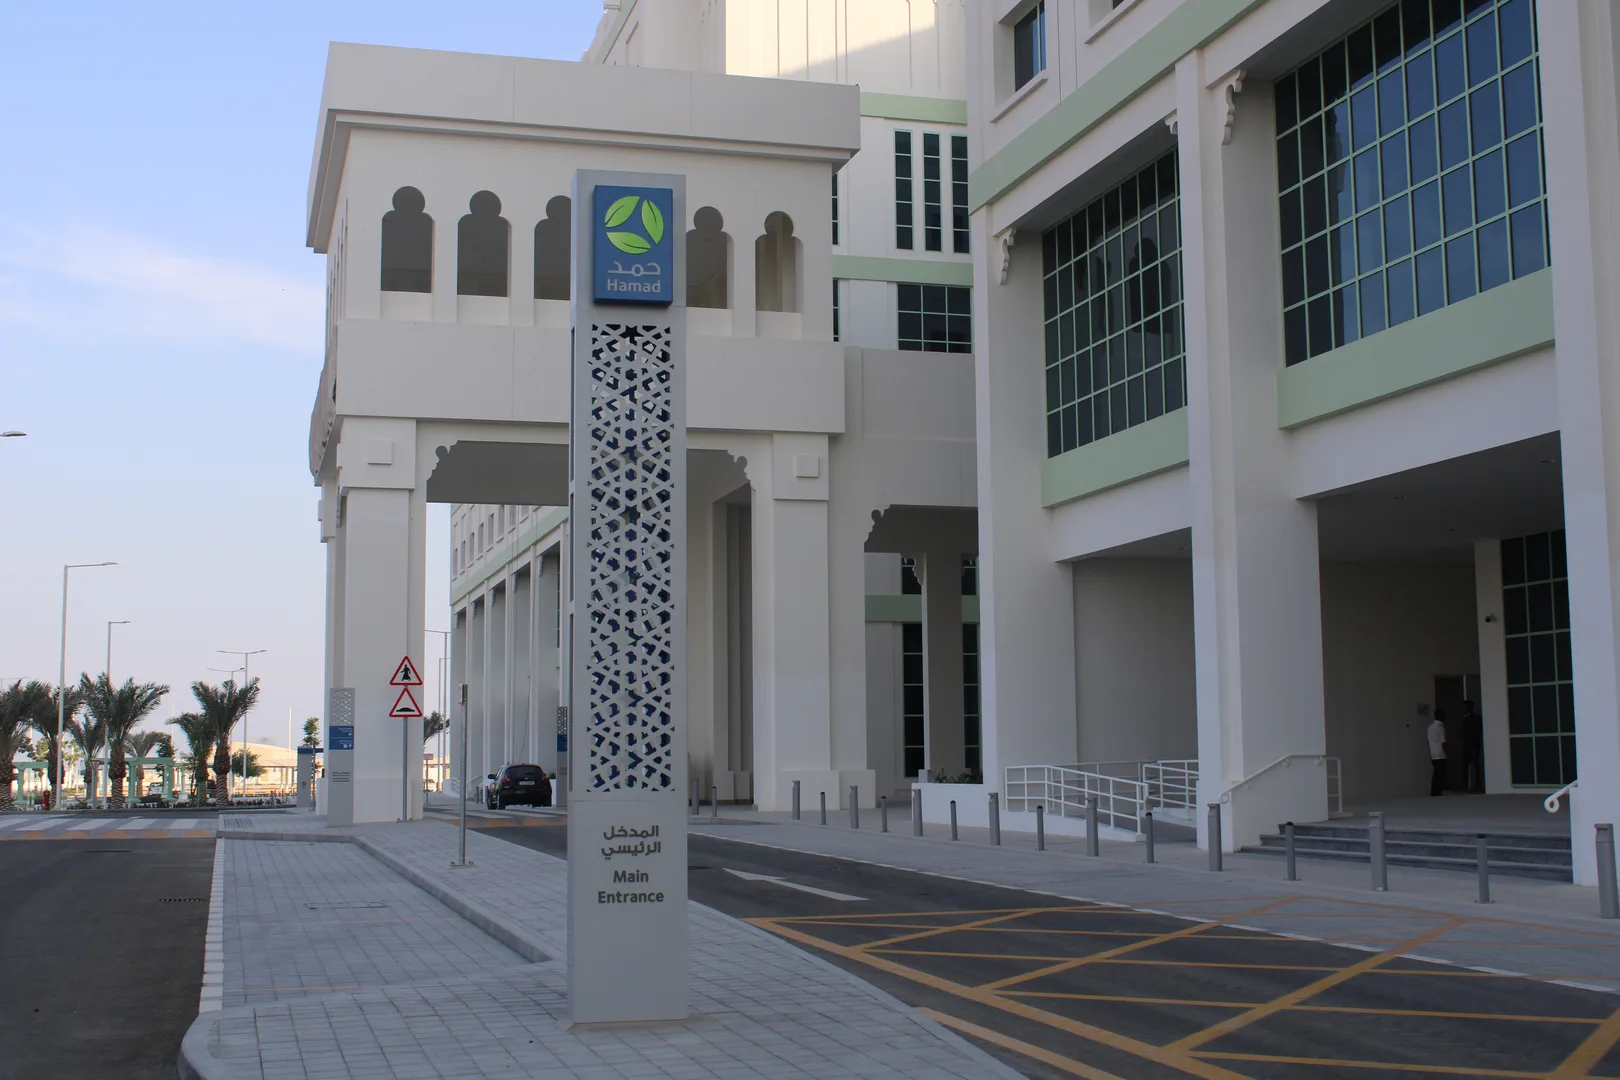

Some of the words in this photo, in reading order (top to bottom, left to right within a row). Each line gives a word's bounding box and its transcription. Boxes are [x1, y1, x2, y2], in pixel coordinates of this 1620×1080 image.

[607, 260, 661, 277] حمد
[607, 278, 661, 293] Hamad
[603, 825, 659, 840] المدخل
[601, 841, 661, 860] الرئيسي
[613, 869, 649, 883] Main
[597, 890, 664, 904] Entrance
